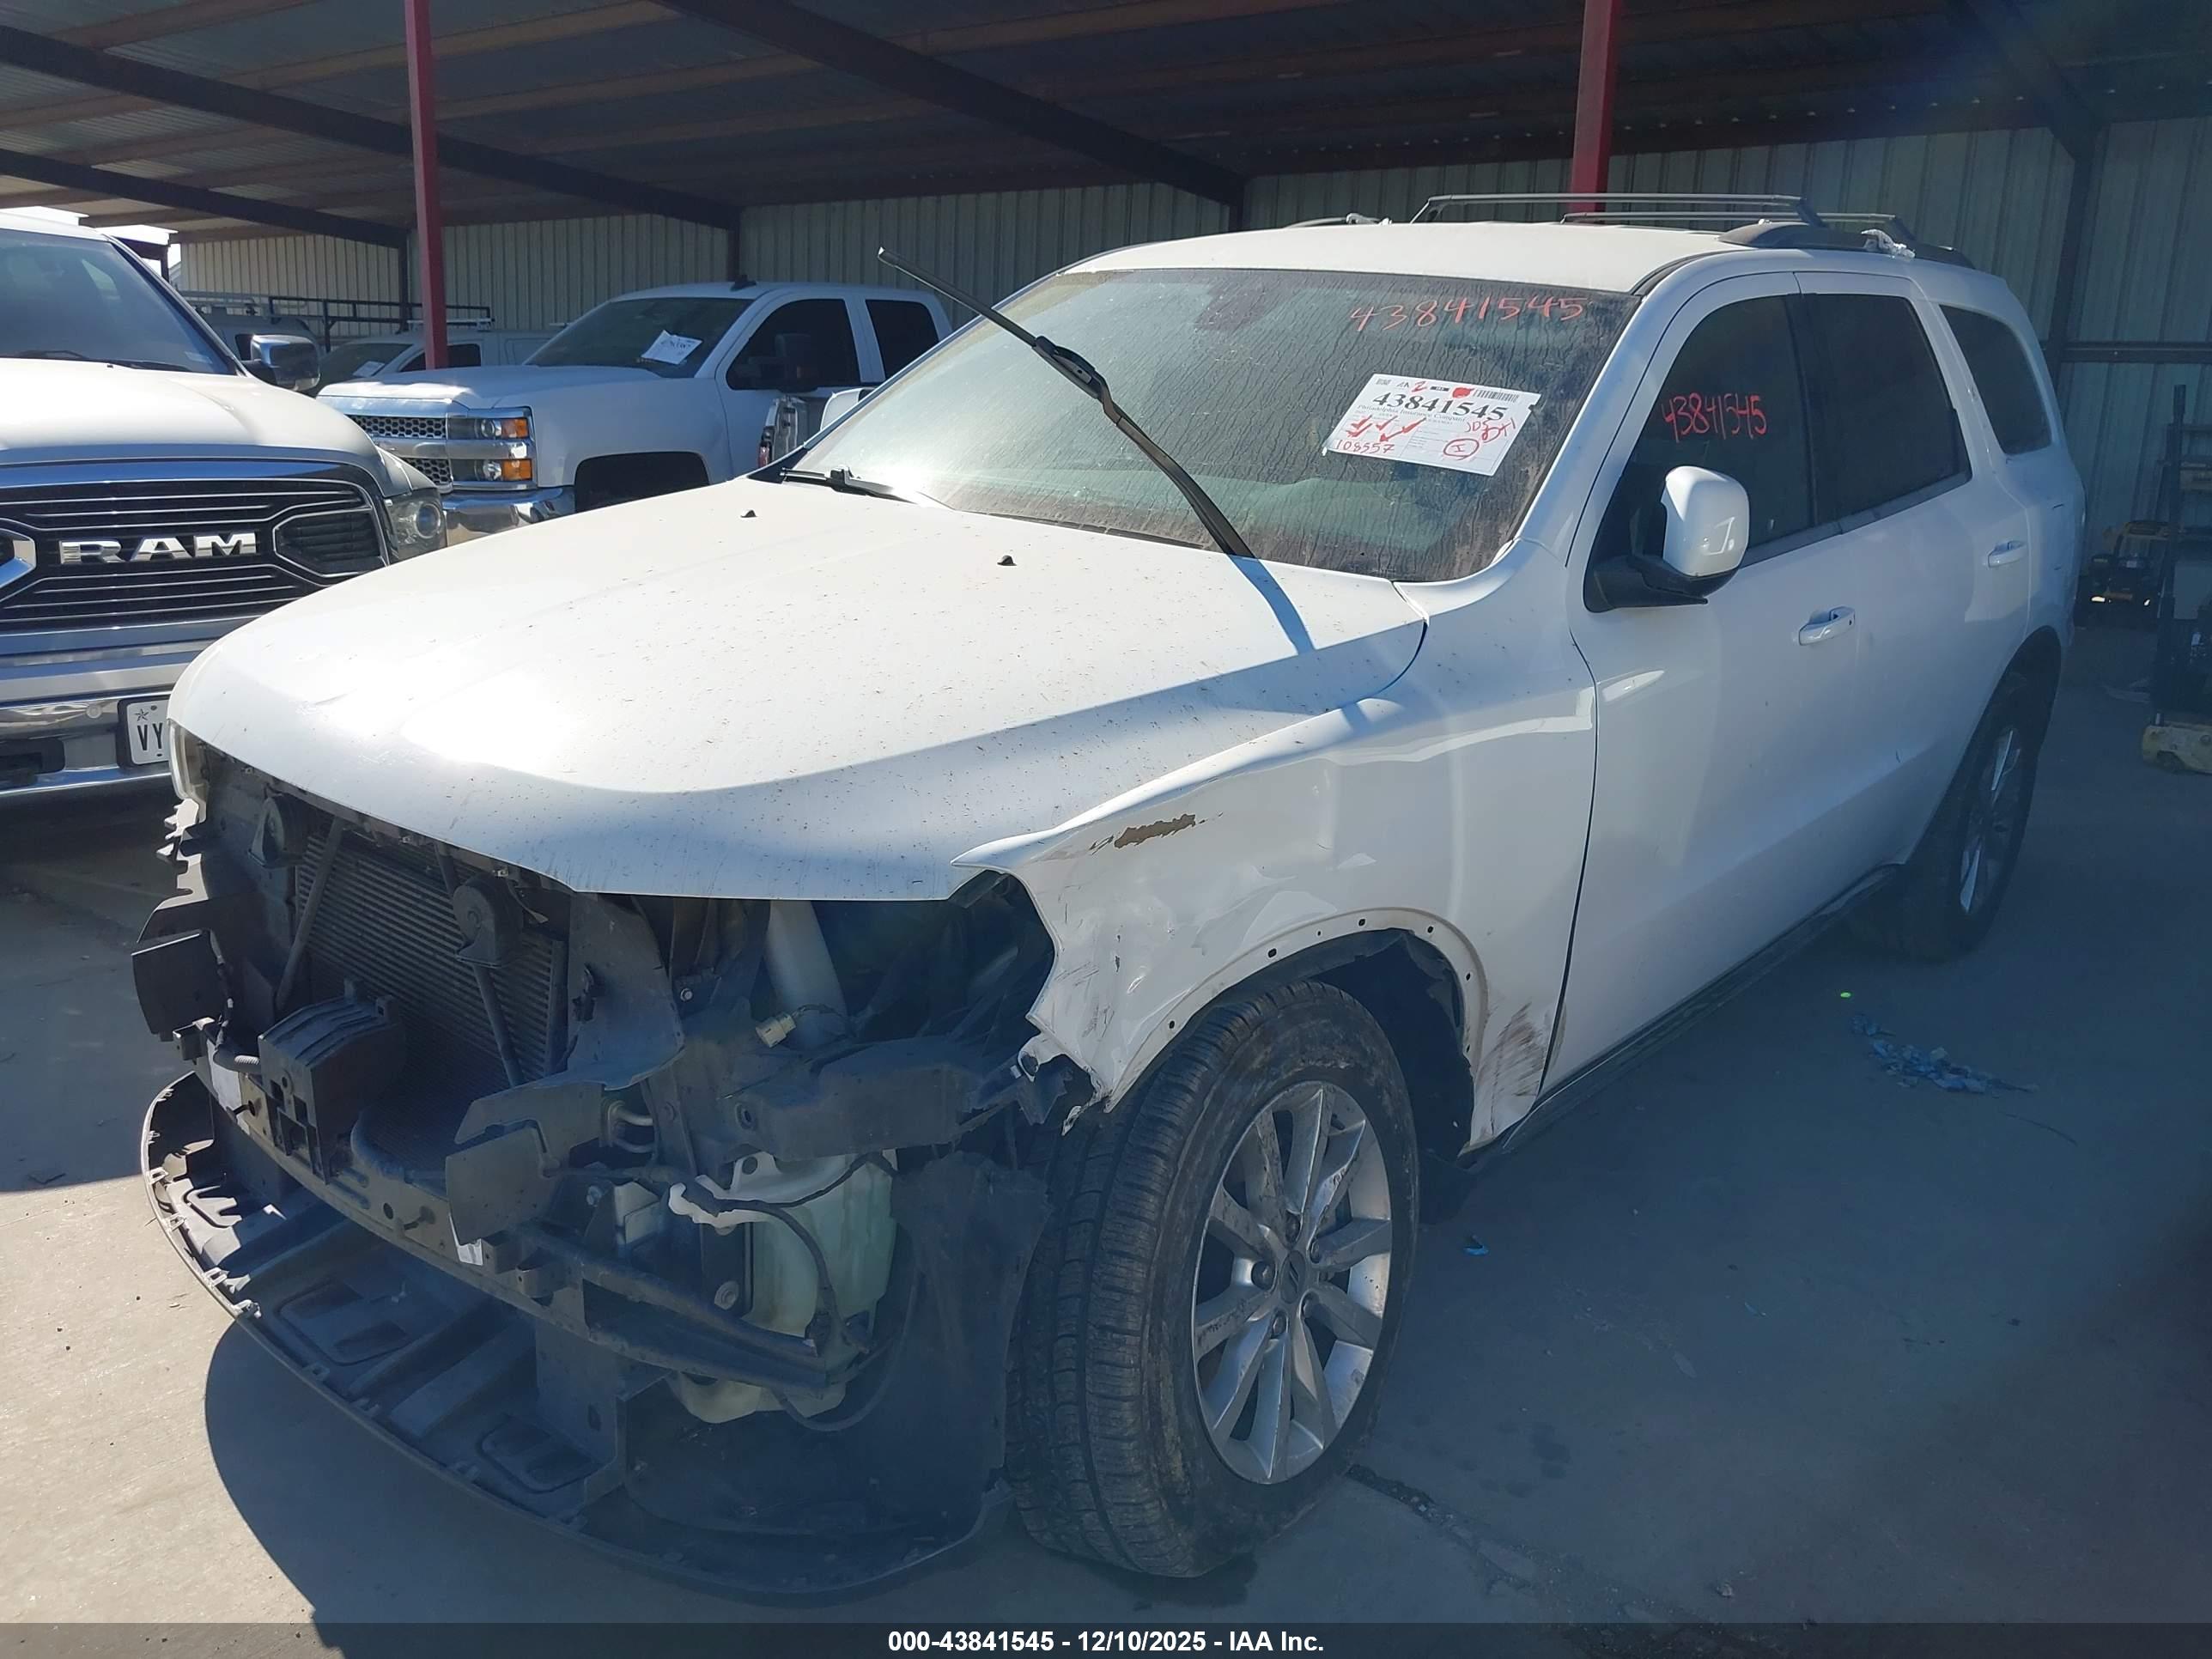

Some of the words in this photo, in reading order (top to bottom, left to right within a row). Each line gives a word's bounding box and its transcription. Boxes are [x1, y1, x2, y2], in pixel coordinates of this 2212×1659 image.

[1351, 295, 1588, 331] 43841545
[1373, 392, 1508, 421] 43841545
[1661, 392, 1766, 443] 43841545
[1336, 439, 1395, 454] 108557
[58, 532, 257, 564] RAM
